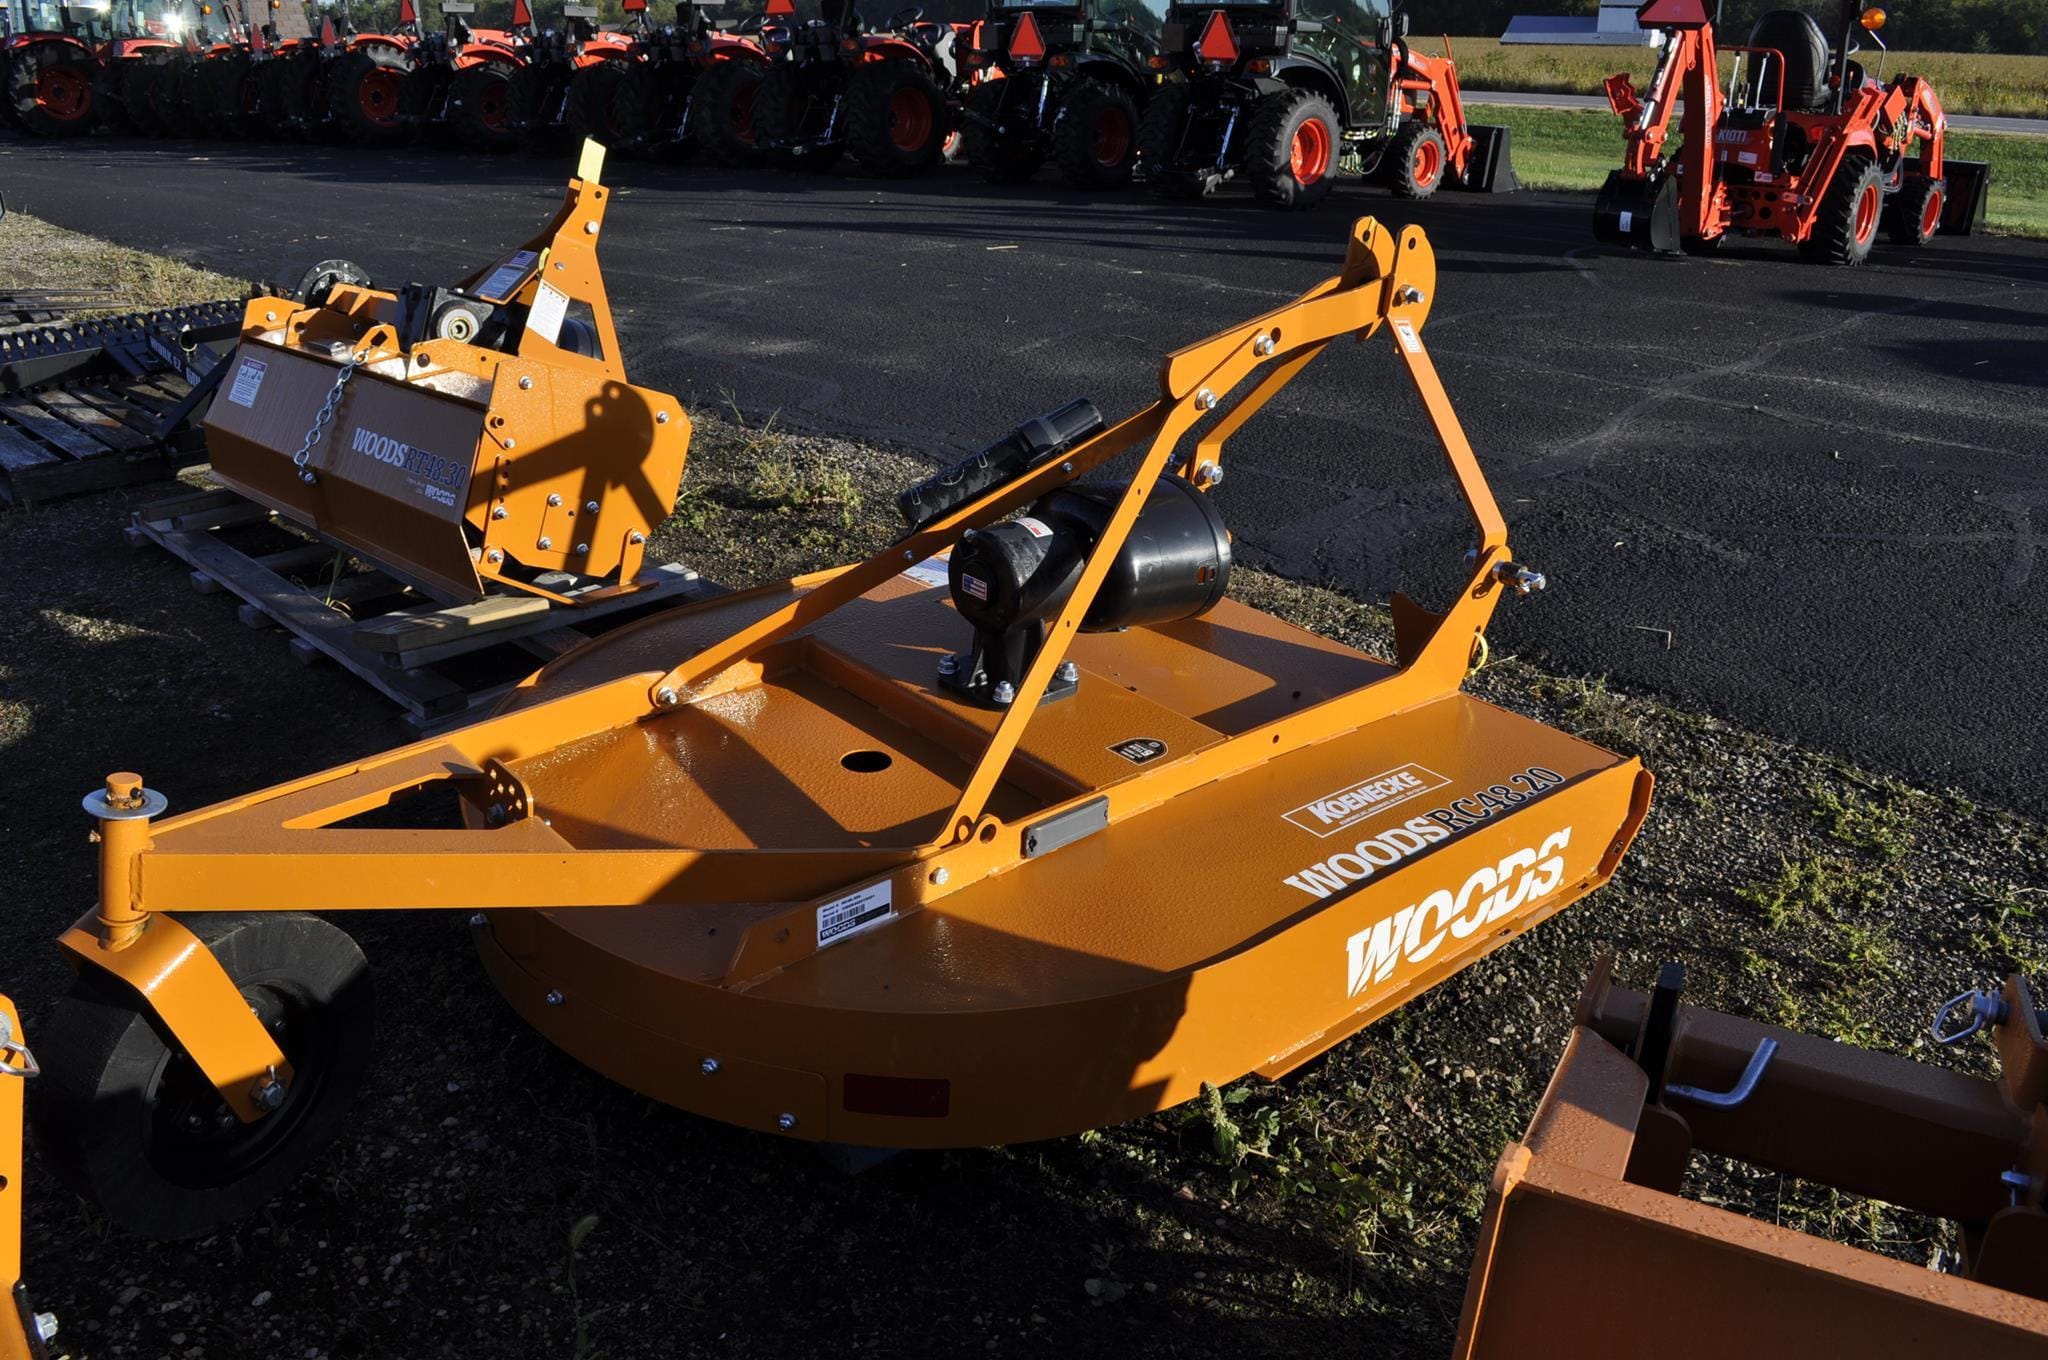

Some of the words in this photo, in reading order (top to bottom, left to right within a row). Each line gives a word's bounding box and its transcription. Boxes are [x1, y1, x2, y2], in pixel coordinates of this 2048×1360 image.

[1718, 129, 1747, 142] KIOTI
[424, 484, 456, 506] WOODS
[1307, 771, 1423, 825] KOENECKE
[1346, 826, 1572, 998] WOODS
[821, 918, 856, 938] WOODS
